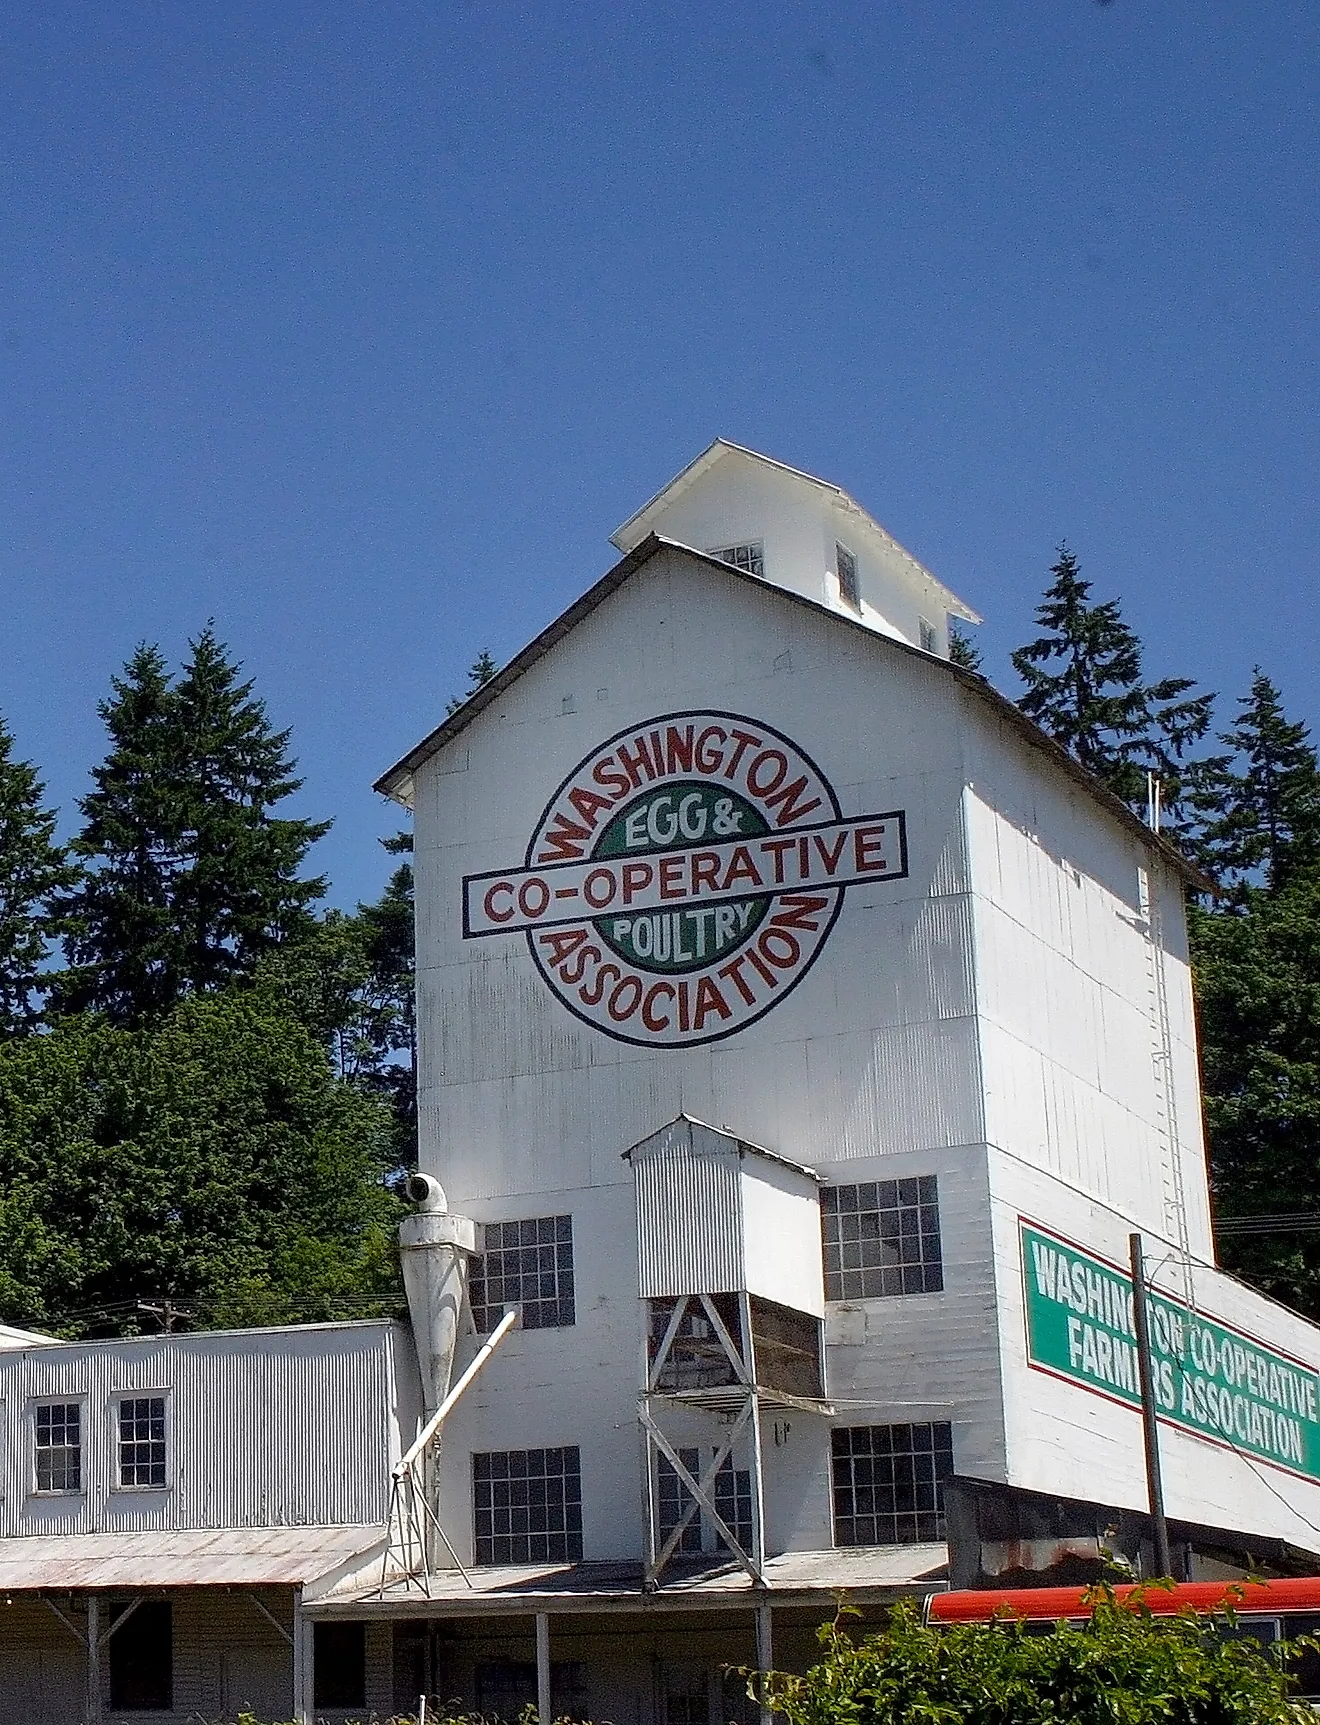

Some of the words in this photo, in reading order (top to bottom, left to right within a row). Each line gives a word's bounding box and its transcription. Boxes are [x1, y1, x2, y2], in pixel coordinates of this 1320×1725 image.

[538, 724, 822, 863] WASHINGTON
[625, 792, 708, 848] EGG
[713, 798, 744, 836] &
[483, 825, 887, 923] CO-OPERATIVE
[539, 895, 830, 1033] ASSOCIATION
[612, 901, 755, 963] POULTRY
[1181, 1369, 1303, 1464] ASSOCIATION
[1189, 1324, 1319, 1423] CO-OPERATIVE
